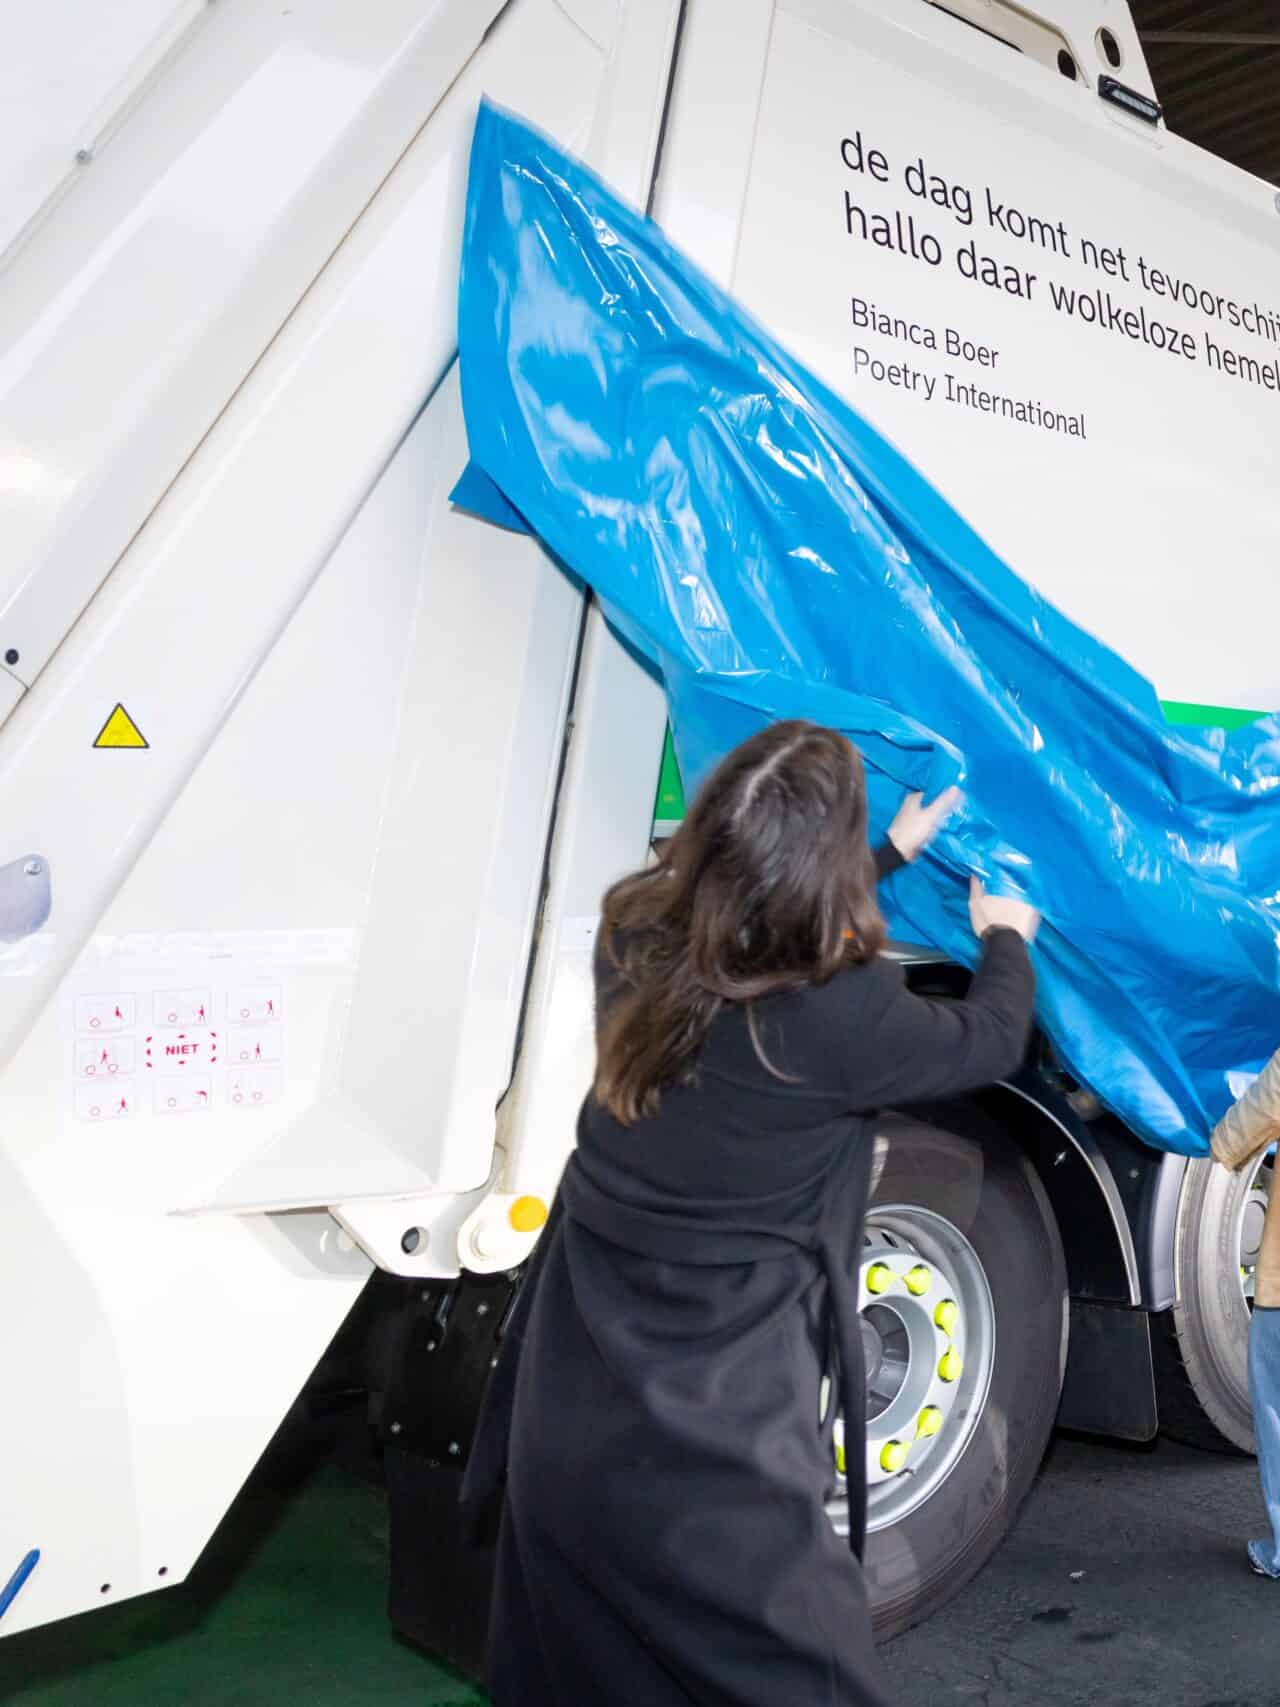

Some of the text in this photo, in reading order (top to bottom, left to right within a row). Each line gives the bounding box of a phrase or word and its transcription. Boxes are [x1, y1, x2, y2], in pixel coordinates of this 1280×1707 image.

[840, 130, 889, 183] de
[904, 157, 973, 226] dag
[985, 187, 1071, 258] komt
[1080, 239, 1130, 282] net
[844, 190, 942, 266] hallo
[956, 239, 1037, 300] daar
[1049, 281, 1196, 361] wolkeloze
[851, 297, 999, 369] Bianca Boer
[853, 347, 1087, 439] Poetry International
[166, 1043, 199, 1056] NIET
